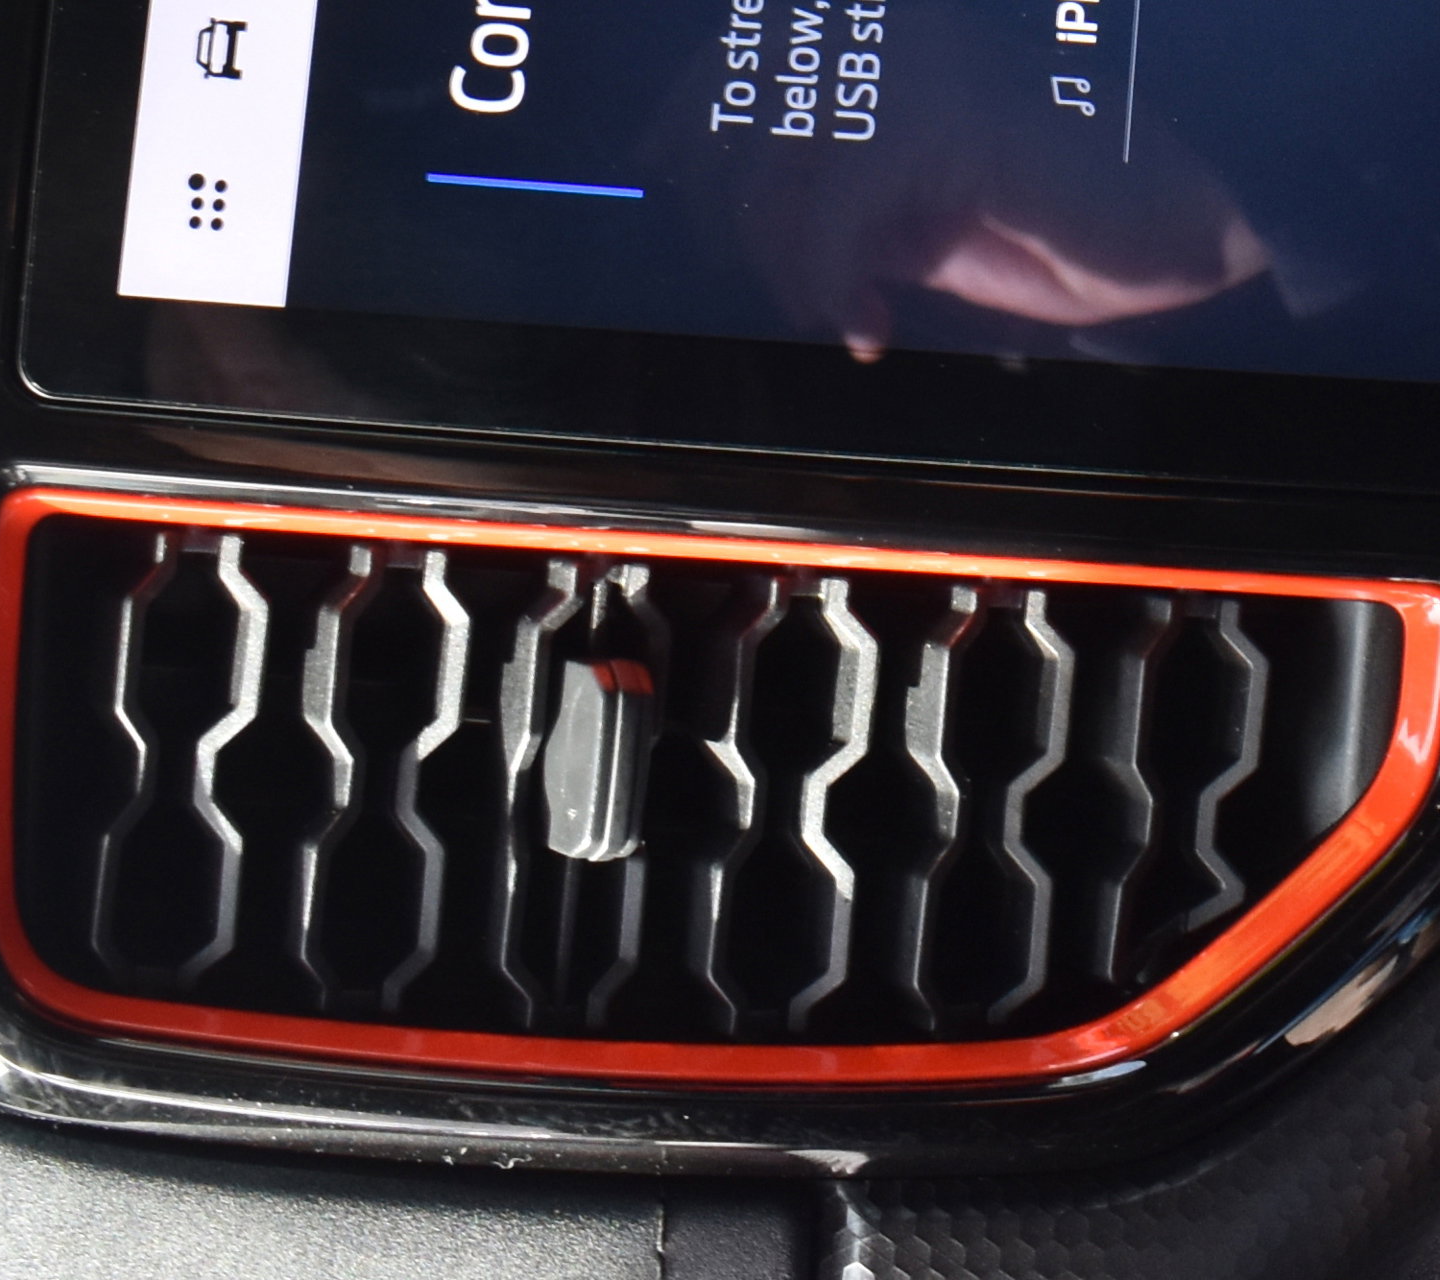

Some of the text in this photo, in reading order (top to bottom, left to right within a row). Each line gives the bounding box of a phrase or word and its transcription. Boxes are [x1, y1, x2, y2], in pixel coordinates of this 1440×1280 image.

[710, 81, 755, 132] To
[770, 0, 831, 138] below,
[831, 51, 881, 141] USB
